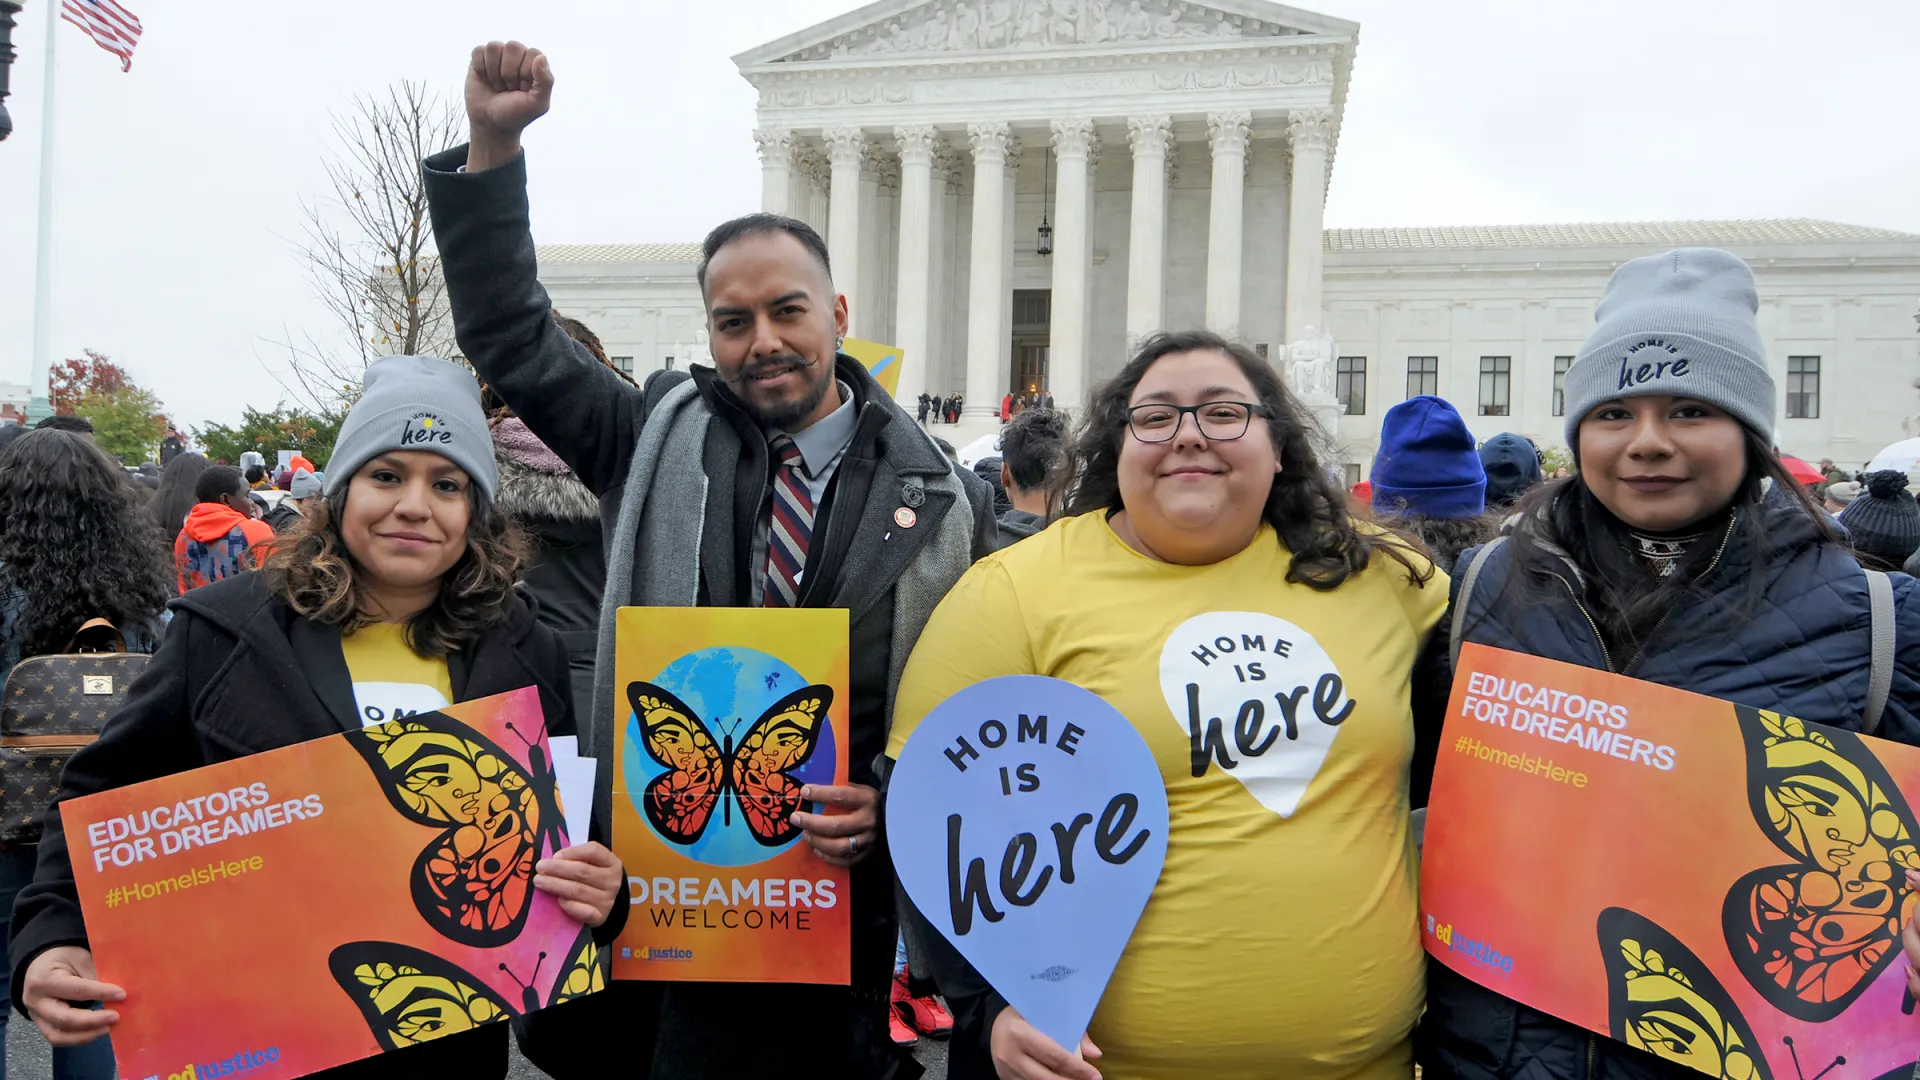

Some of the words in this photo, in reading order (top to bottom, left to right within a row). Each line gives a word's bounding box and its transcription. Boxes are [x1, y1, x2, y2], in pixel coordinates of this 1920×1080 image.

[1629, 339, 1664, 353] HOME
[1665, 344, 1677, 354] IS
[1618, 357, 1690, 390] here
[400, 420, 452, 445] here
[1191, 634, 1293, 666] HOME
[1233, 662, 1266, 682] IS
[1185, 673, 1356, 778] here
[1467, 671, 1629, 729] EDUCATORS
[943, 714, 1086, 773] HOME
[1461, 695, 1510, 727] FOR
[1511, 707, 1677, 771] DREAMERS
[999, 762, 1041, 796] IS
[1455, 735, 1589, 788] #HomeIsHere
[87, 782, 270, 847] EDUCATORS
[93, 836, 157, 873] FOR
[160, 794, 324, 855] DREAMERS
[105, 855, 264, 908] #HomeIsHere
[947, 793, 1150, 936] here
[629, 876, 837, 909] DREAMERS
[650, 908, 811, 931] WELCOME
